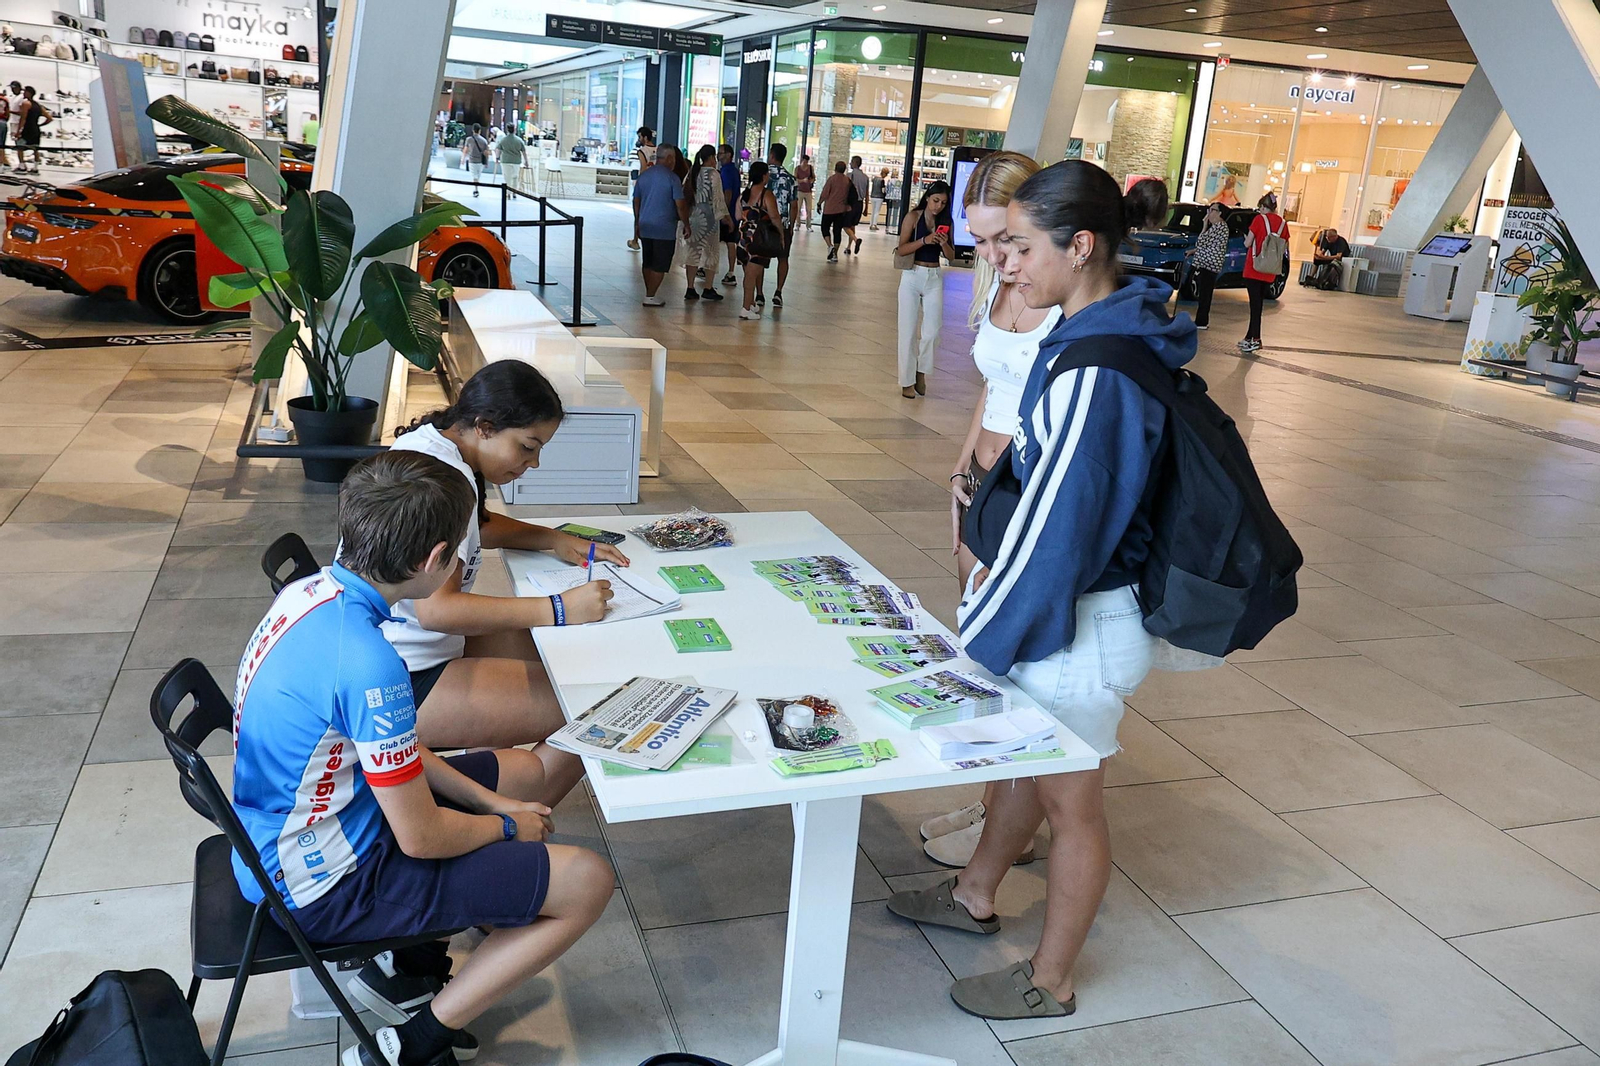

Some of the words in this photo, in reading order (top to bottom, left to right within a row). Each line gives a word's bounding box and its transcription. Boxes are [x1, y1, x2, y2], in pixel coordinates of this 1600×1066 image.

[203, 12, 288, 36] mayka
[218, 35, 274, 47] footwear
[1507, 210, 1548, 221] ESCOGER
[1502, 229, 1543, 241] REGALO
[647, 697, 711, 750] Atlántico
[380, 741, 398, 751] Club
[370, 741, 419, 767] Vigué
